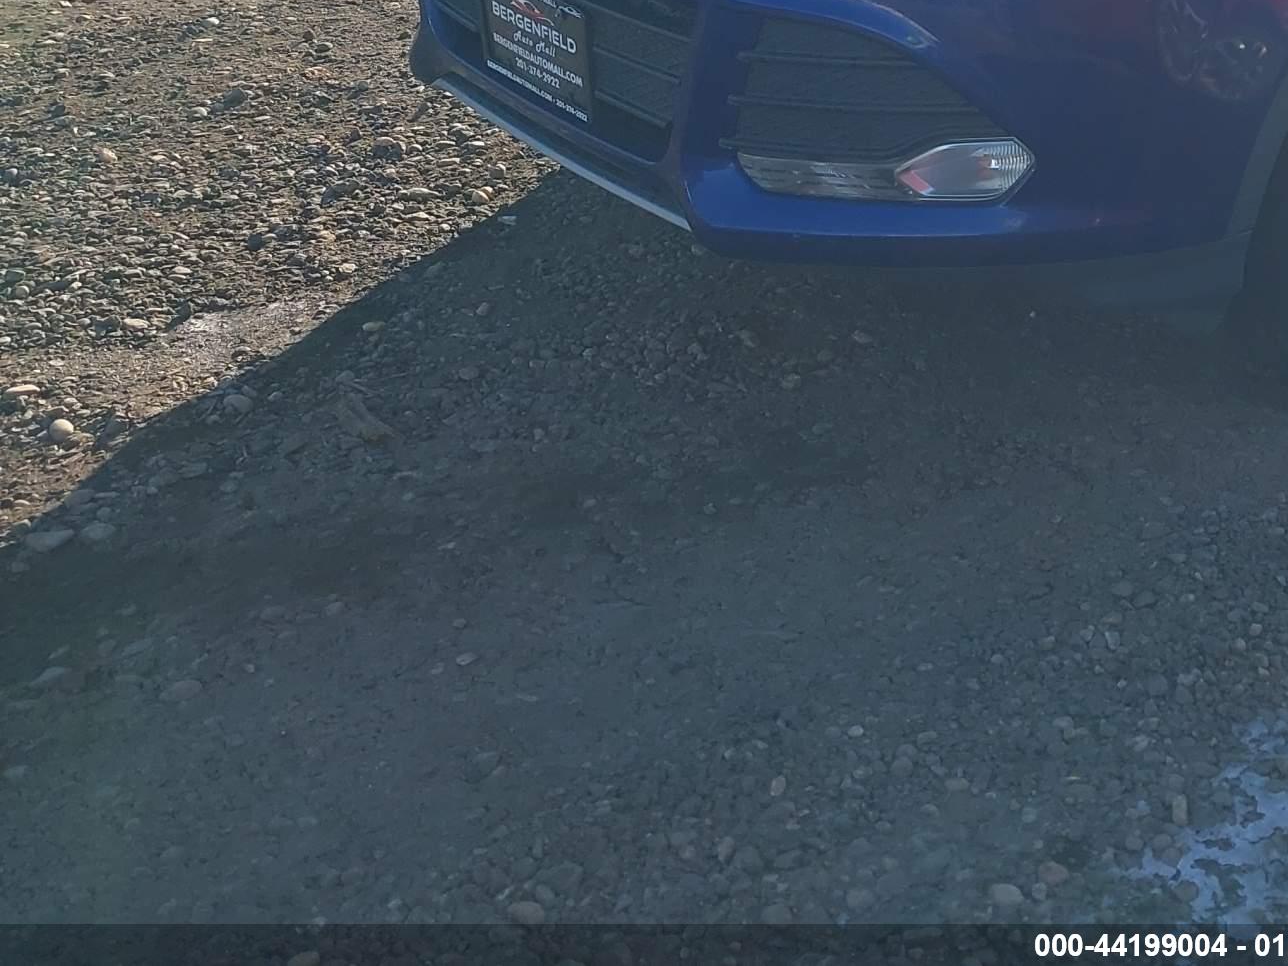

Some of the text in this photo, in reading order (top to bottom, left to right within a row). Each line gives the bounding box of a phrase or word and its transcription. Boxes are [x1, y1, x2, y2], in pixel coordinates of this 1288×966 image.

[491, 0, 577, 54] BERGENFIELD
[513, 31, 556, 57] Auto Mall
[493, 32, 583, 88] BERGENFIELDAUTOMALL.COM
